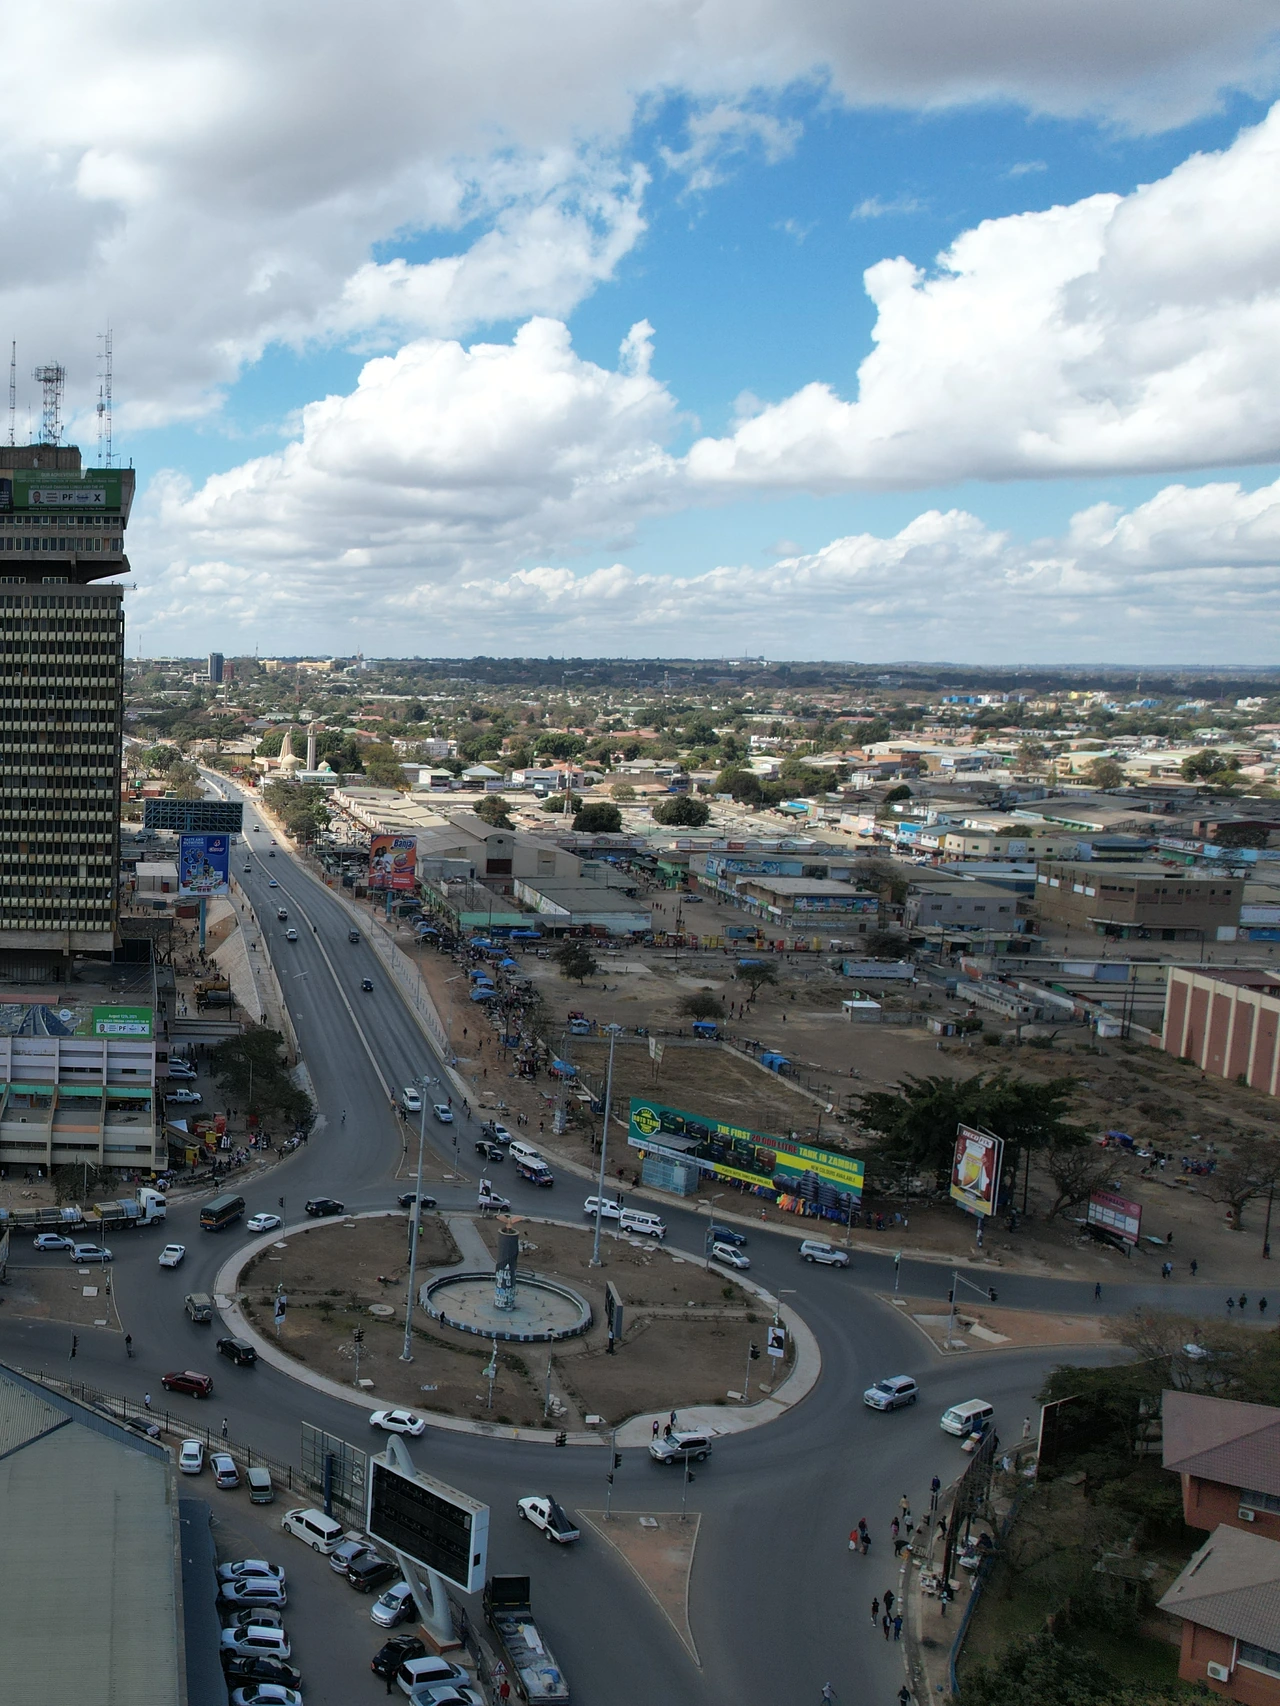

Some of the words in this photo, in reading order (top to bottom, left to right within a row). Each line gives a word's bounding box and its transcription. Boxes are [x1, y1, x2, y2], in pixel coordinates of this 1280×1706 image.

[62, 493, 73, 501] PF
[717, 1124, 730, 1135] THE
[730, 1128, 751, 1140] FIRST
[777, 1143, 797, 1154] LITRE
[799, 1147, 818, 1159] TANK
[819, 1153, 826, 1162] IN
[827, 1155, 858, 1172] ZAMBIA
